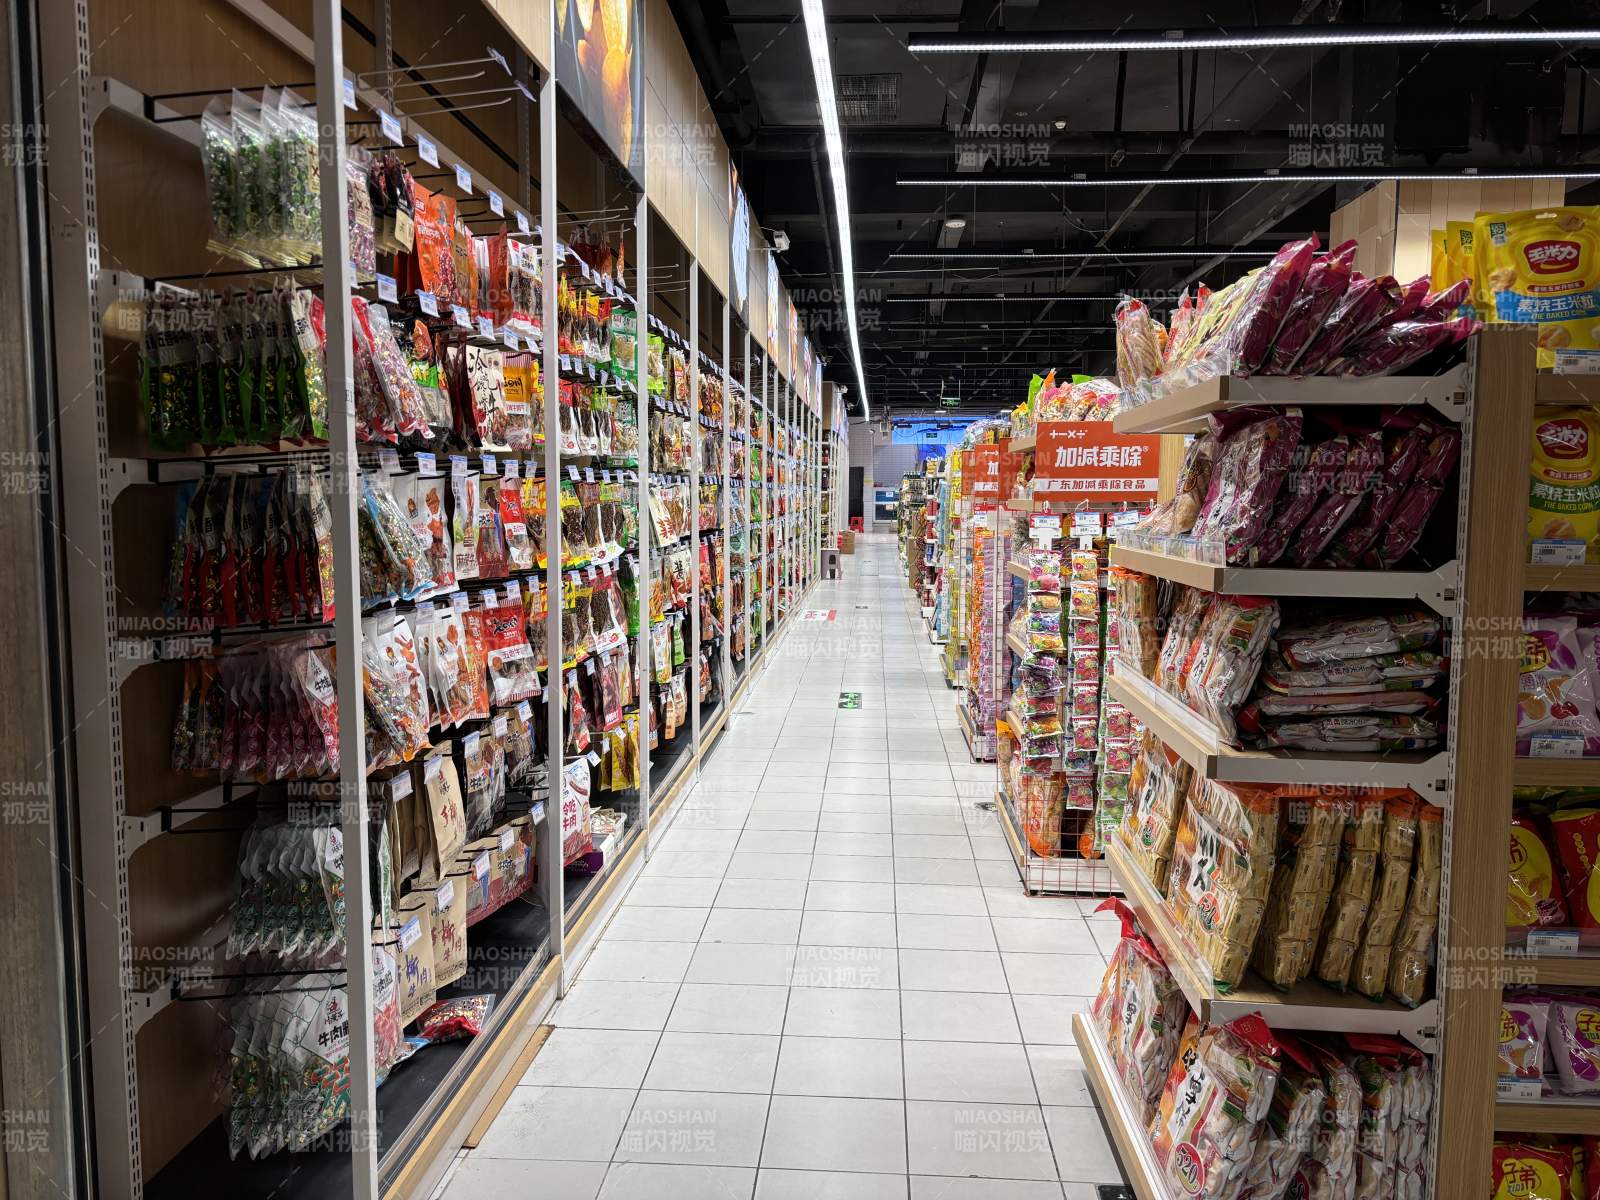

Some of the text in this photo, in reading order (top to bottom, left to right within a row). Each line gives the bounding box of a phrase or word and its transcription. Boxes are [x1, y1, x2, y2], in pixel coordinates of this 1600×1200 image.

[1055, 446, 1142, 467] 加减乘除
[1047, 480, 1146, 490] 广东加减乘除食品
